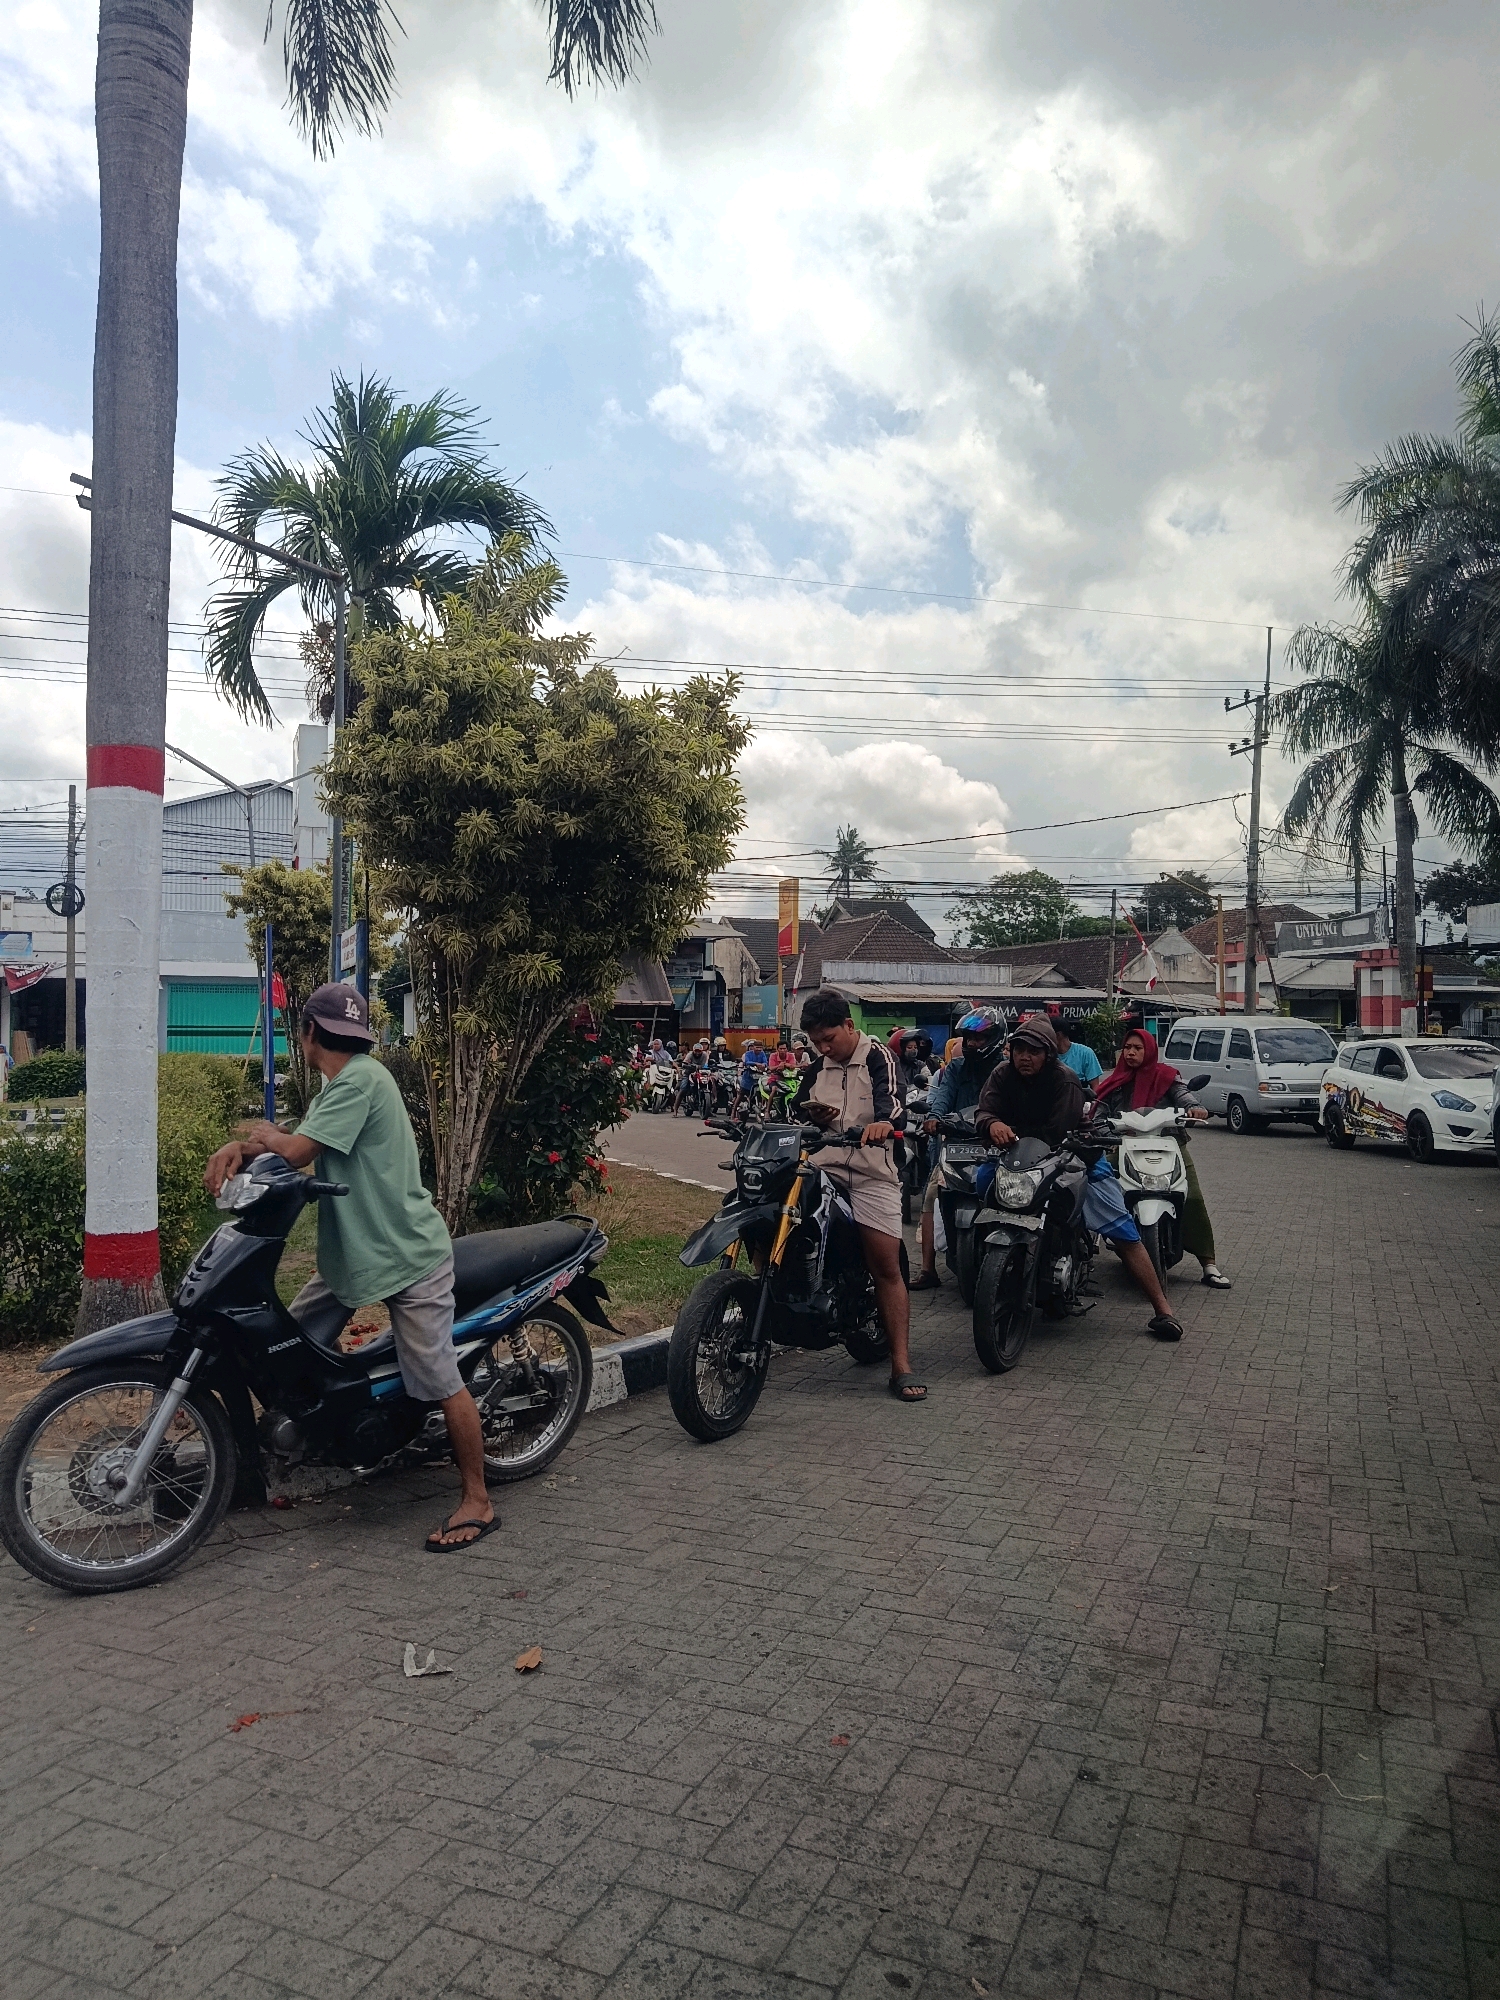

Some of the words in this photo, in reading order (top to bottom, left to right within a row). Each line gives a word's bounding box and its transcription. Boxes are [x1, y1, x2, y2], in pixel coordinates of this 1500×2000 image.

[1295, 922, 1338, 938] UNTUNG
[345, 997, 360, 1020] LA
[267, 1336, 303, 1354] HONDA
